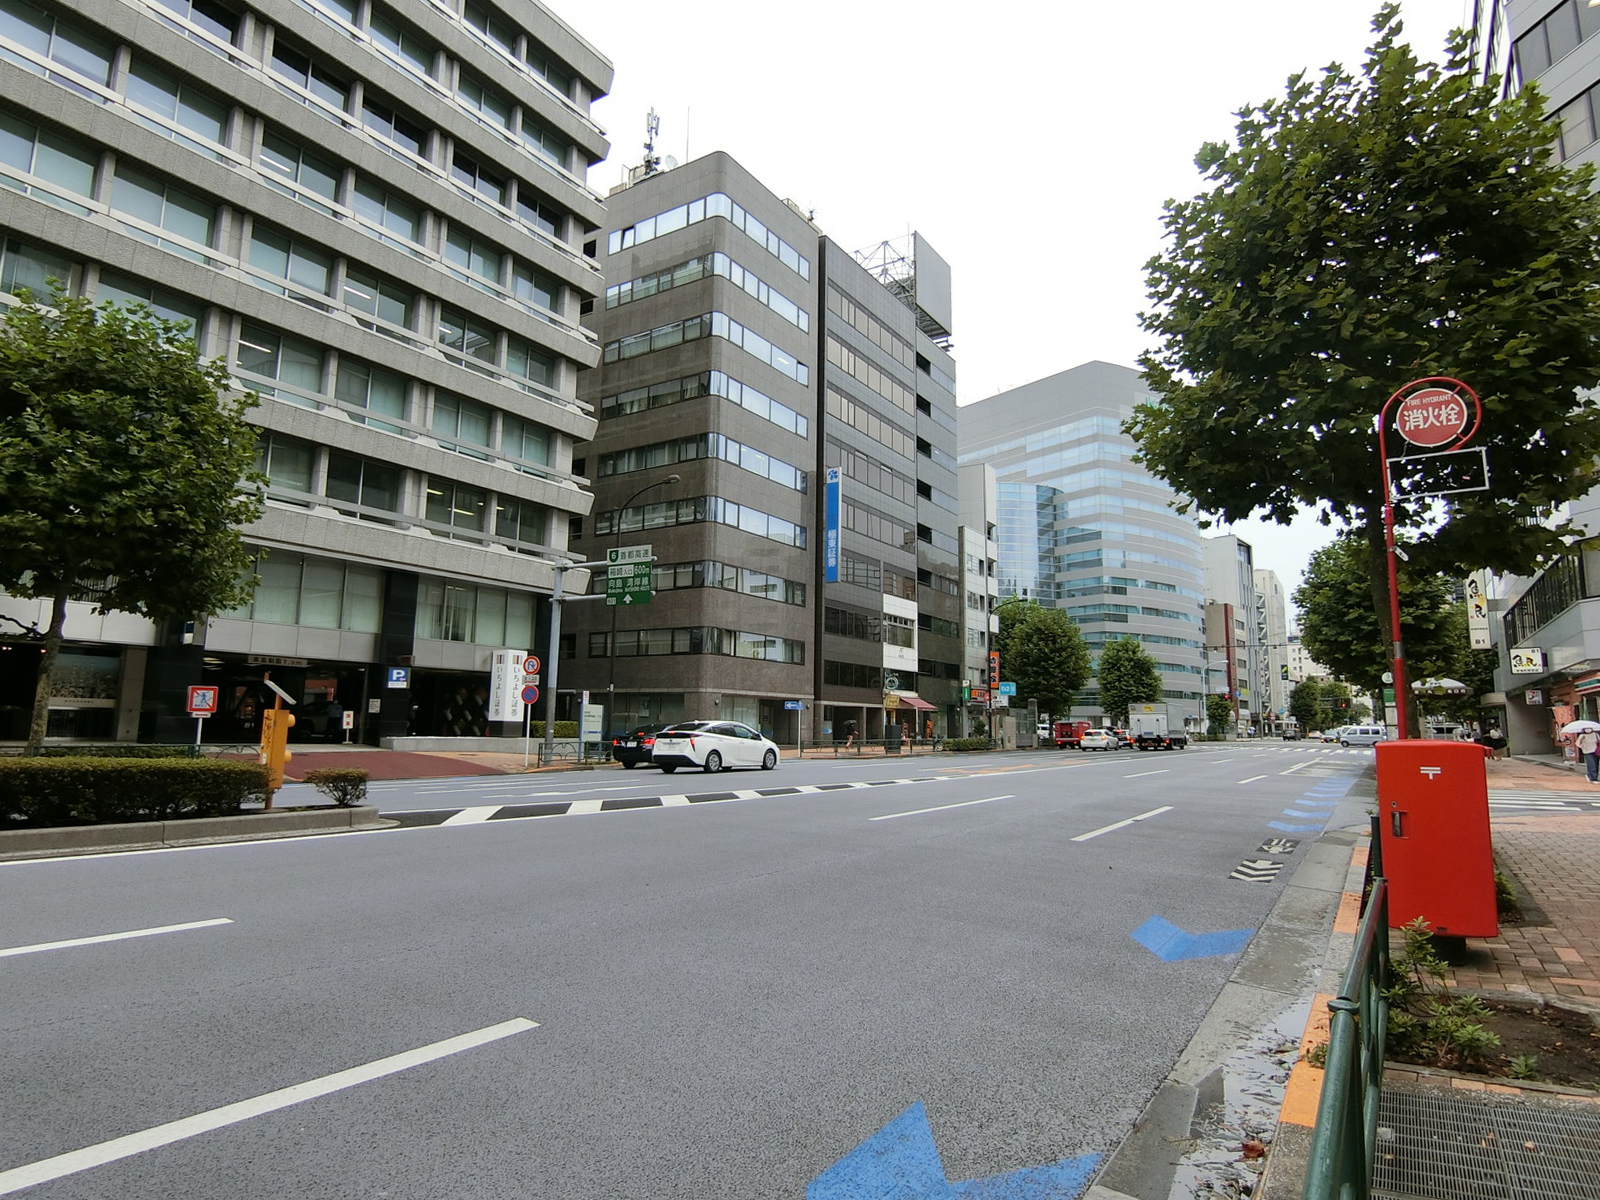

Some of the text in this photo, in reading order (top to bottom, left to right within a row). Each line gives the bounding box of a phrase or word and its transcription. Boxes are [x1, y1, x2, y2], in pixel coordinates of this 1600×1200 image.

[1406, 394, 1451, 407] FIRE HYDRANT
[1403, 403, 1460, 431] 消火栓
[611, 551, 617, 559] 6
[620, 549, 650, 560] 首都高速
[608, 576, 650, 588] 向島 湾岸線
[392, 669, 405, 681] P
[494, 666, 503, 717] いちよし証券
[511, 666, 521, 717] いちよし証券
